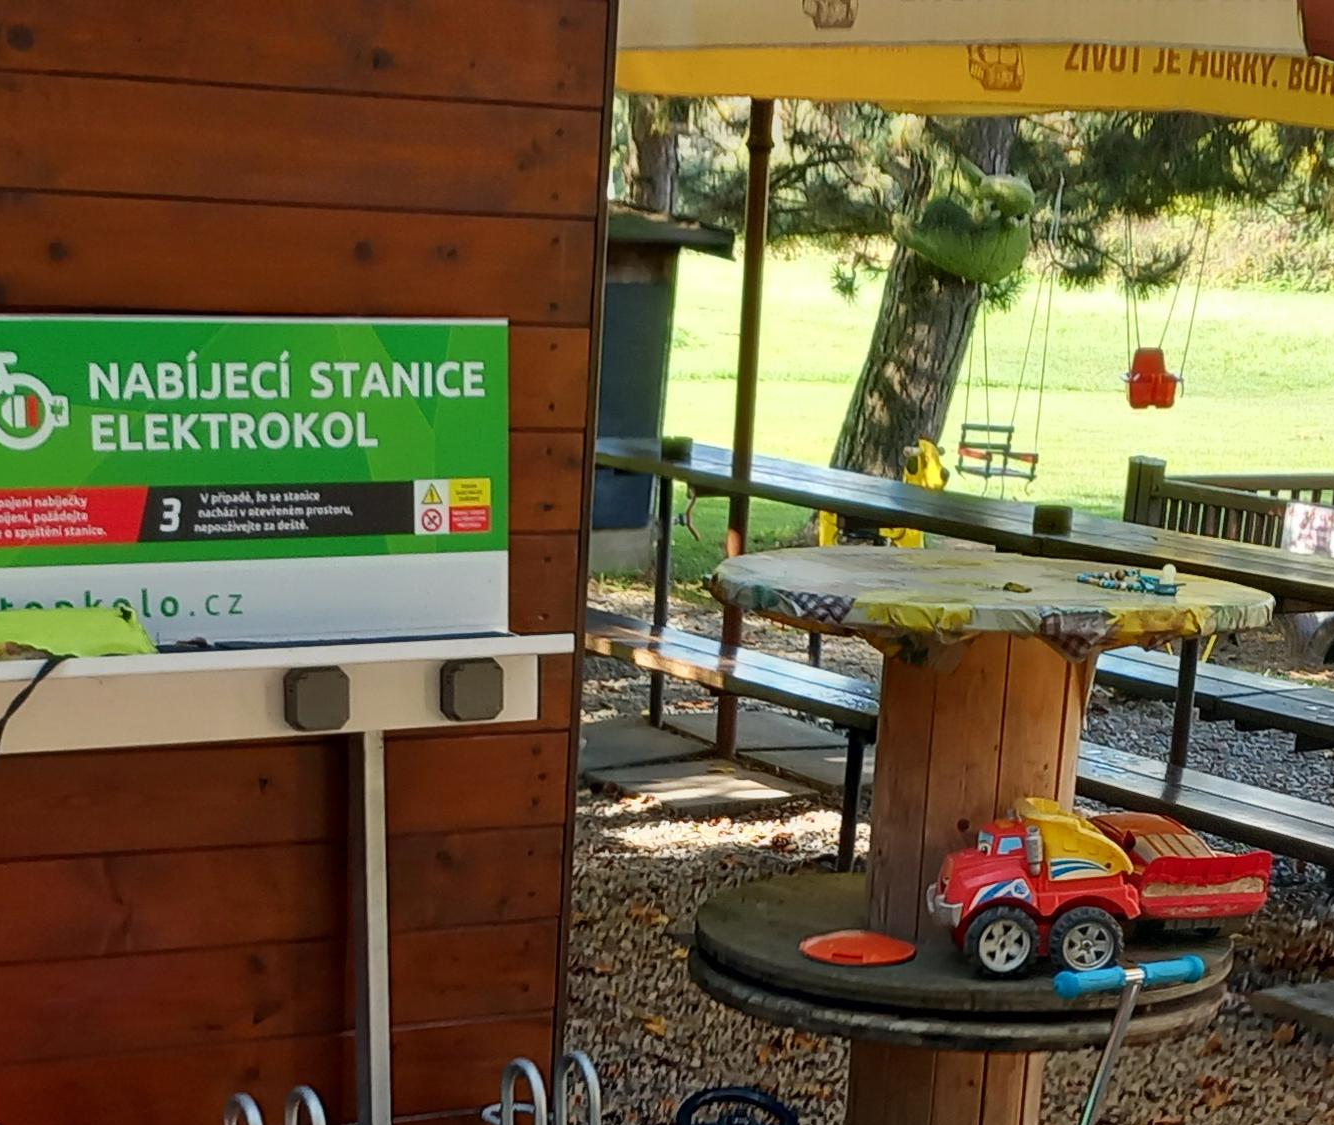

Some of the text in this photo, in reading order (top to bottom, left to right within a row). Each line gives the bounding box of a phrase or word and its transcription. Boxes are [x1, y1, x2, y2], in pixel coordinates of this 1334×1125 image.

[1152, 47, 1181, 75] JE
[88, 350, 485, 400] NABÍJECÍ STANICE
[91, 411, 378, 451] ELEKTROKOL
[199, 492, 209, 504] V
[269, 492, 281, 503] se
[283, 489, 320, 502] stanice
[159, 497, 182, 532] 3
[239, 508, 247, 517] v
[4, 529, 13, 539] o
[263, 522, 276, 531] za
